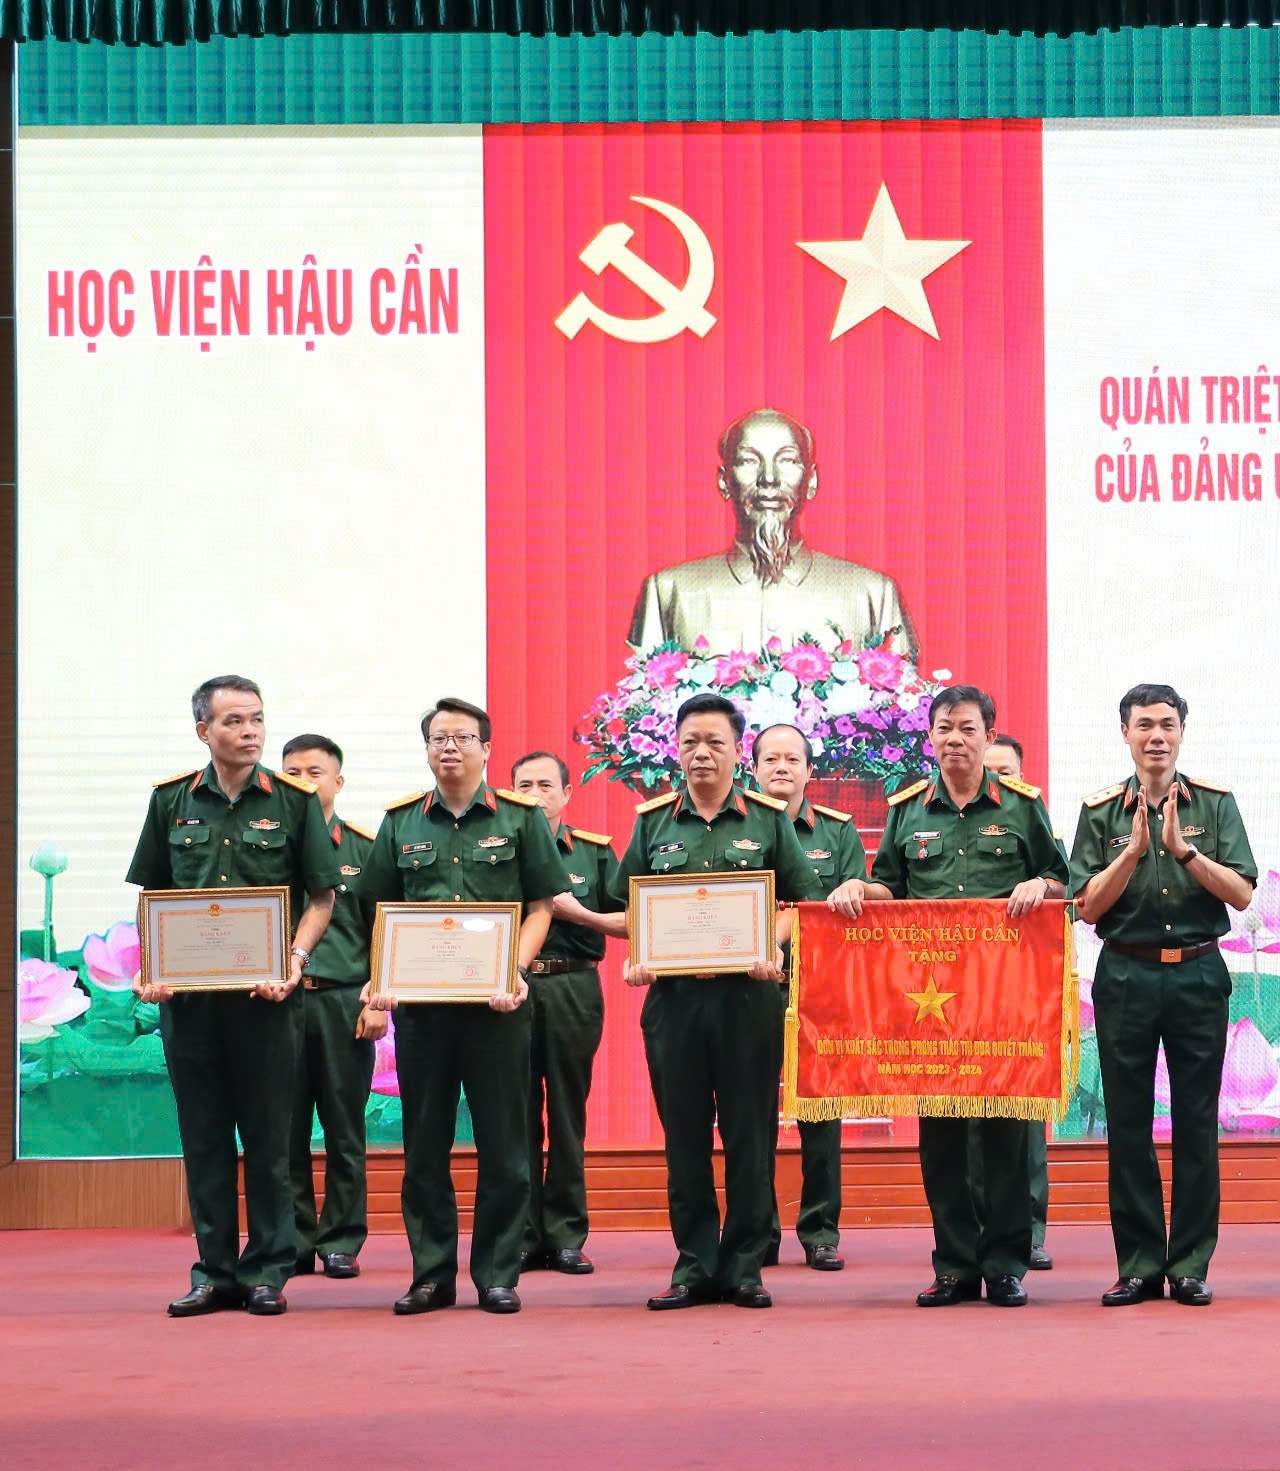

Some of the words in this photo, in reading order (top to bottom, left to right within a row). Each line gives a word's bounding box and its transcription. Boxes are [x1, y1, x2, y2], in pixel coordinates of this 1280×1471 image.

[48, 269, 135, 352] HỌC
[151, 255, 250, 352] VIỆN
[267, 254, 353, 351] HẬU
[370, 244, 459, 335] CẦN
[1100, 366, 1190, 430] QUÁN
[1095, 438, 1160, 503] CỦA
[1171, 437, 1262, 502] ĐẢNG
[844, 927, 884, 944] HỌC
[888, 923, 932, 944] VIỆN
[938, 923, 977, 945] HẬU
[981, 921, 1019, 942] CẦN
[908, 948, 957, 964] TẶNG
[878, 1062, 900, 1074] NĂM
[903, 1063, 923, 1076] HỌC
[926, 1064, 950, 1075] 2023
[960, 1064, 982, 1075] 2024
